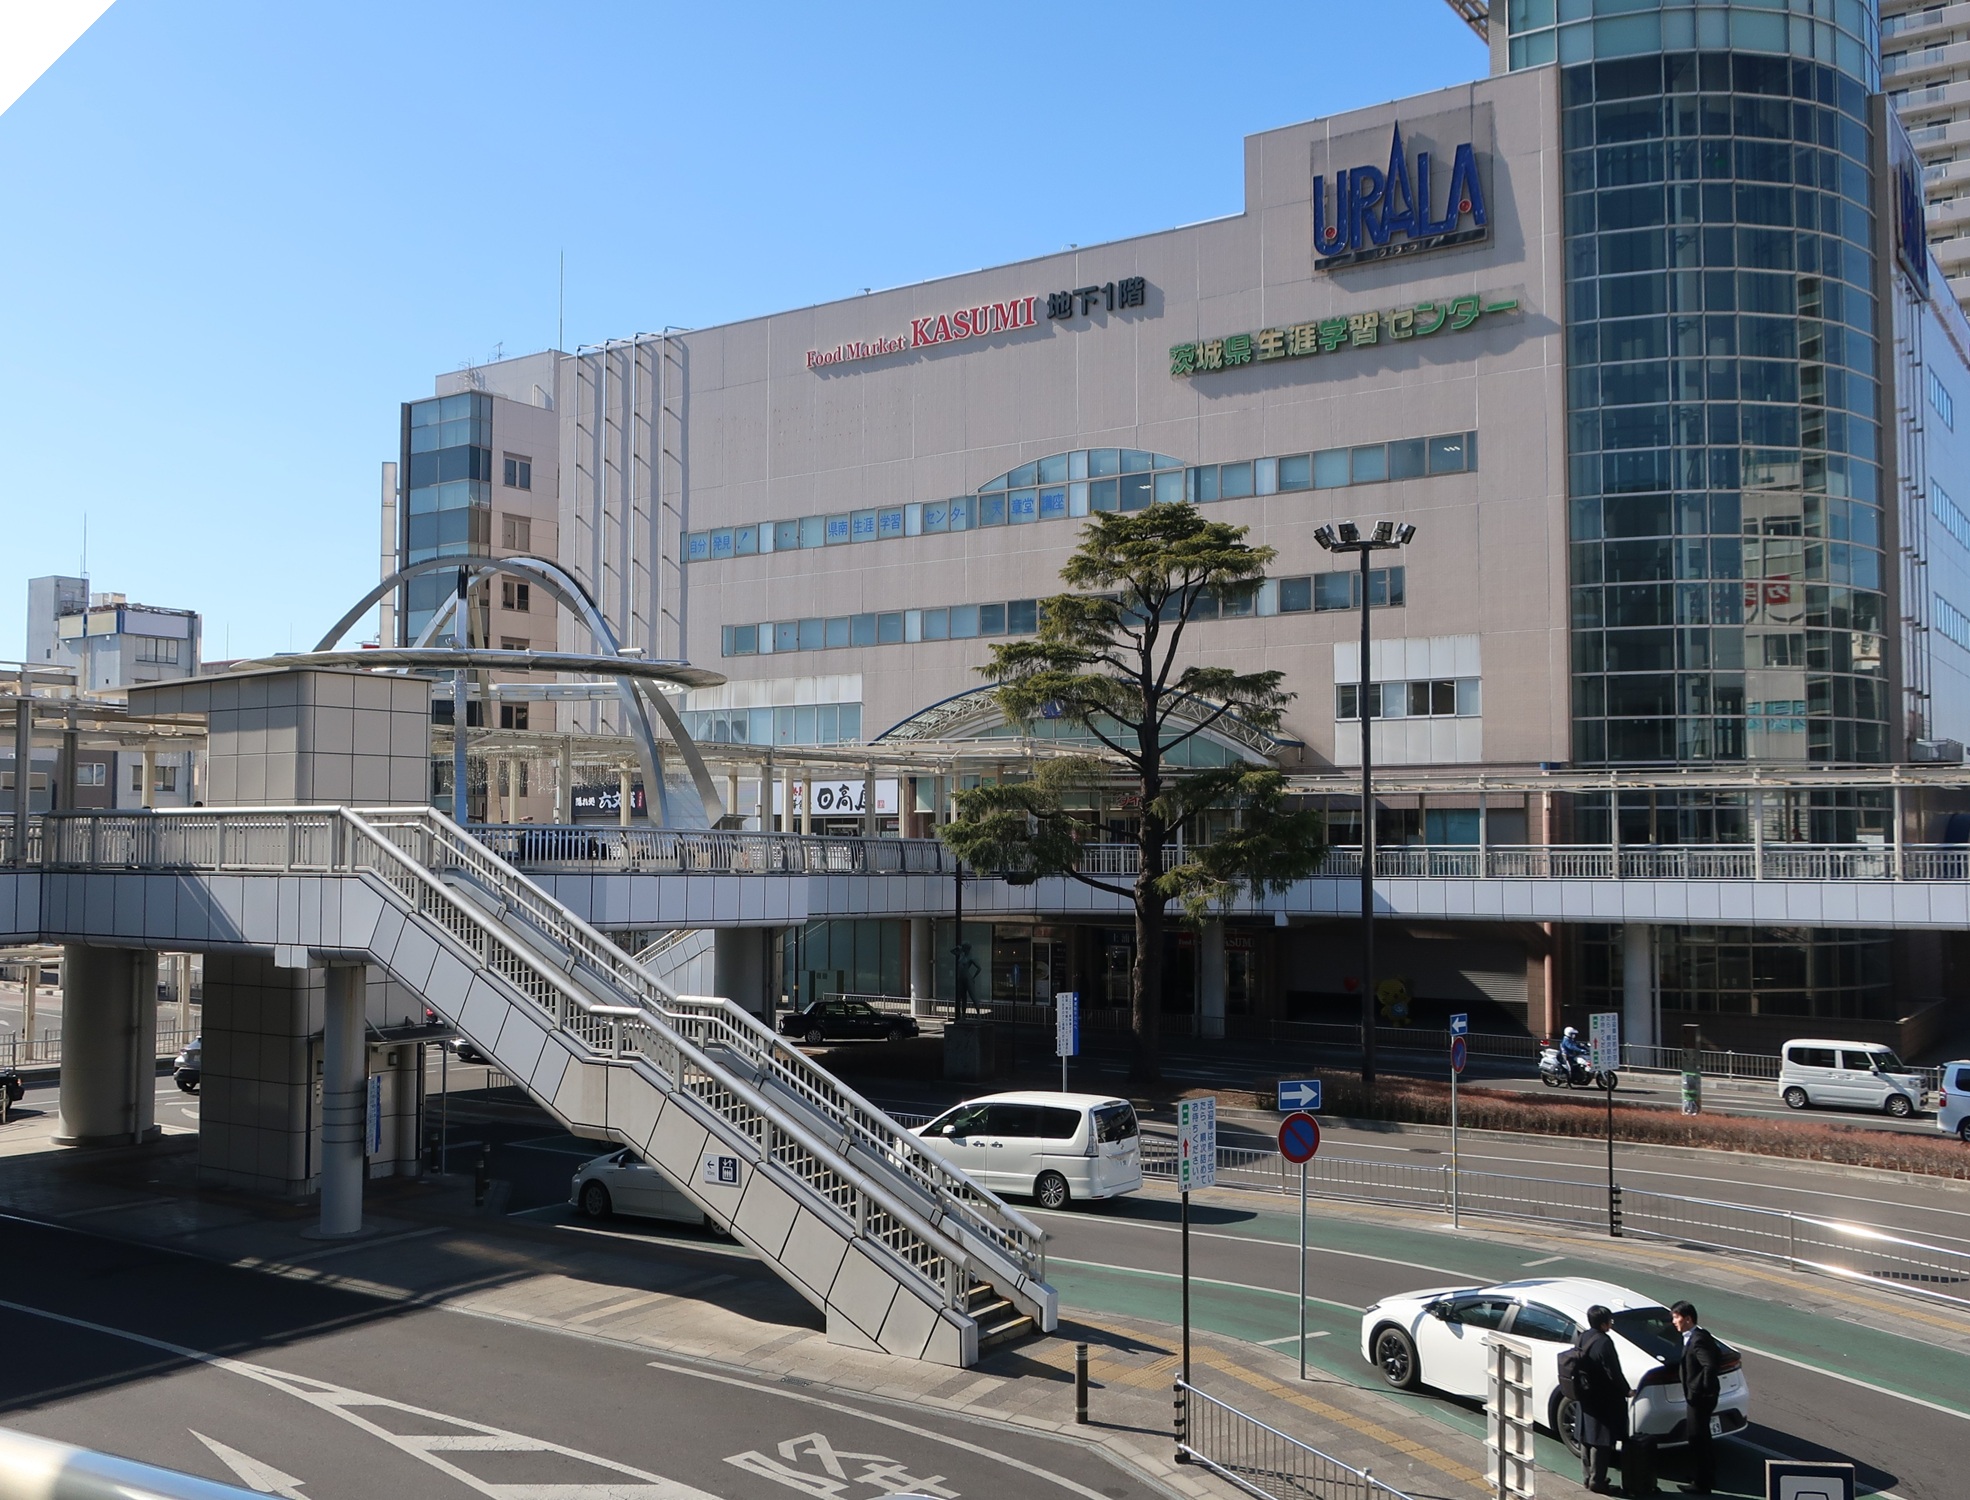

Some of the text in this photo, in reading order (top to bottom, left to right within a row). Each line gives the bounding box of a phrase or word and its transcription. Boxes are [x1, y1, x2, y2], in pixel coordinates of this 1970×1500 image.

[1313, 119, 1488, 256] URALA
[806, 276, 1145, 367] Food Market KASUMI 地下1階
[1169, 294, 1518, 375] 茨城県生涯学習センター
